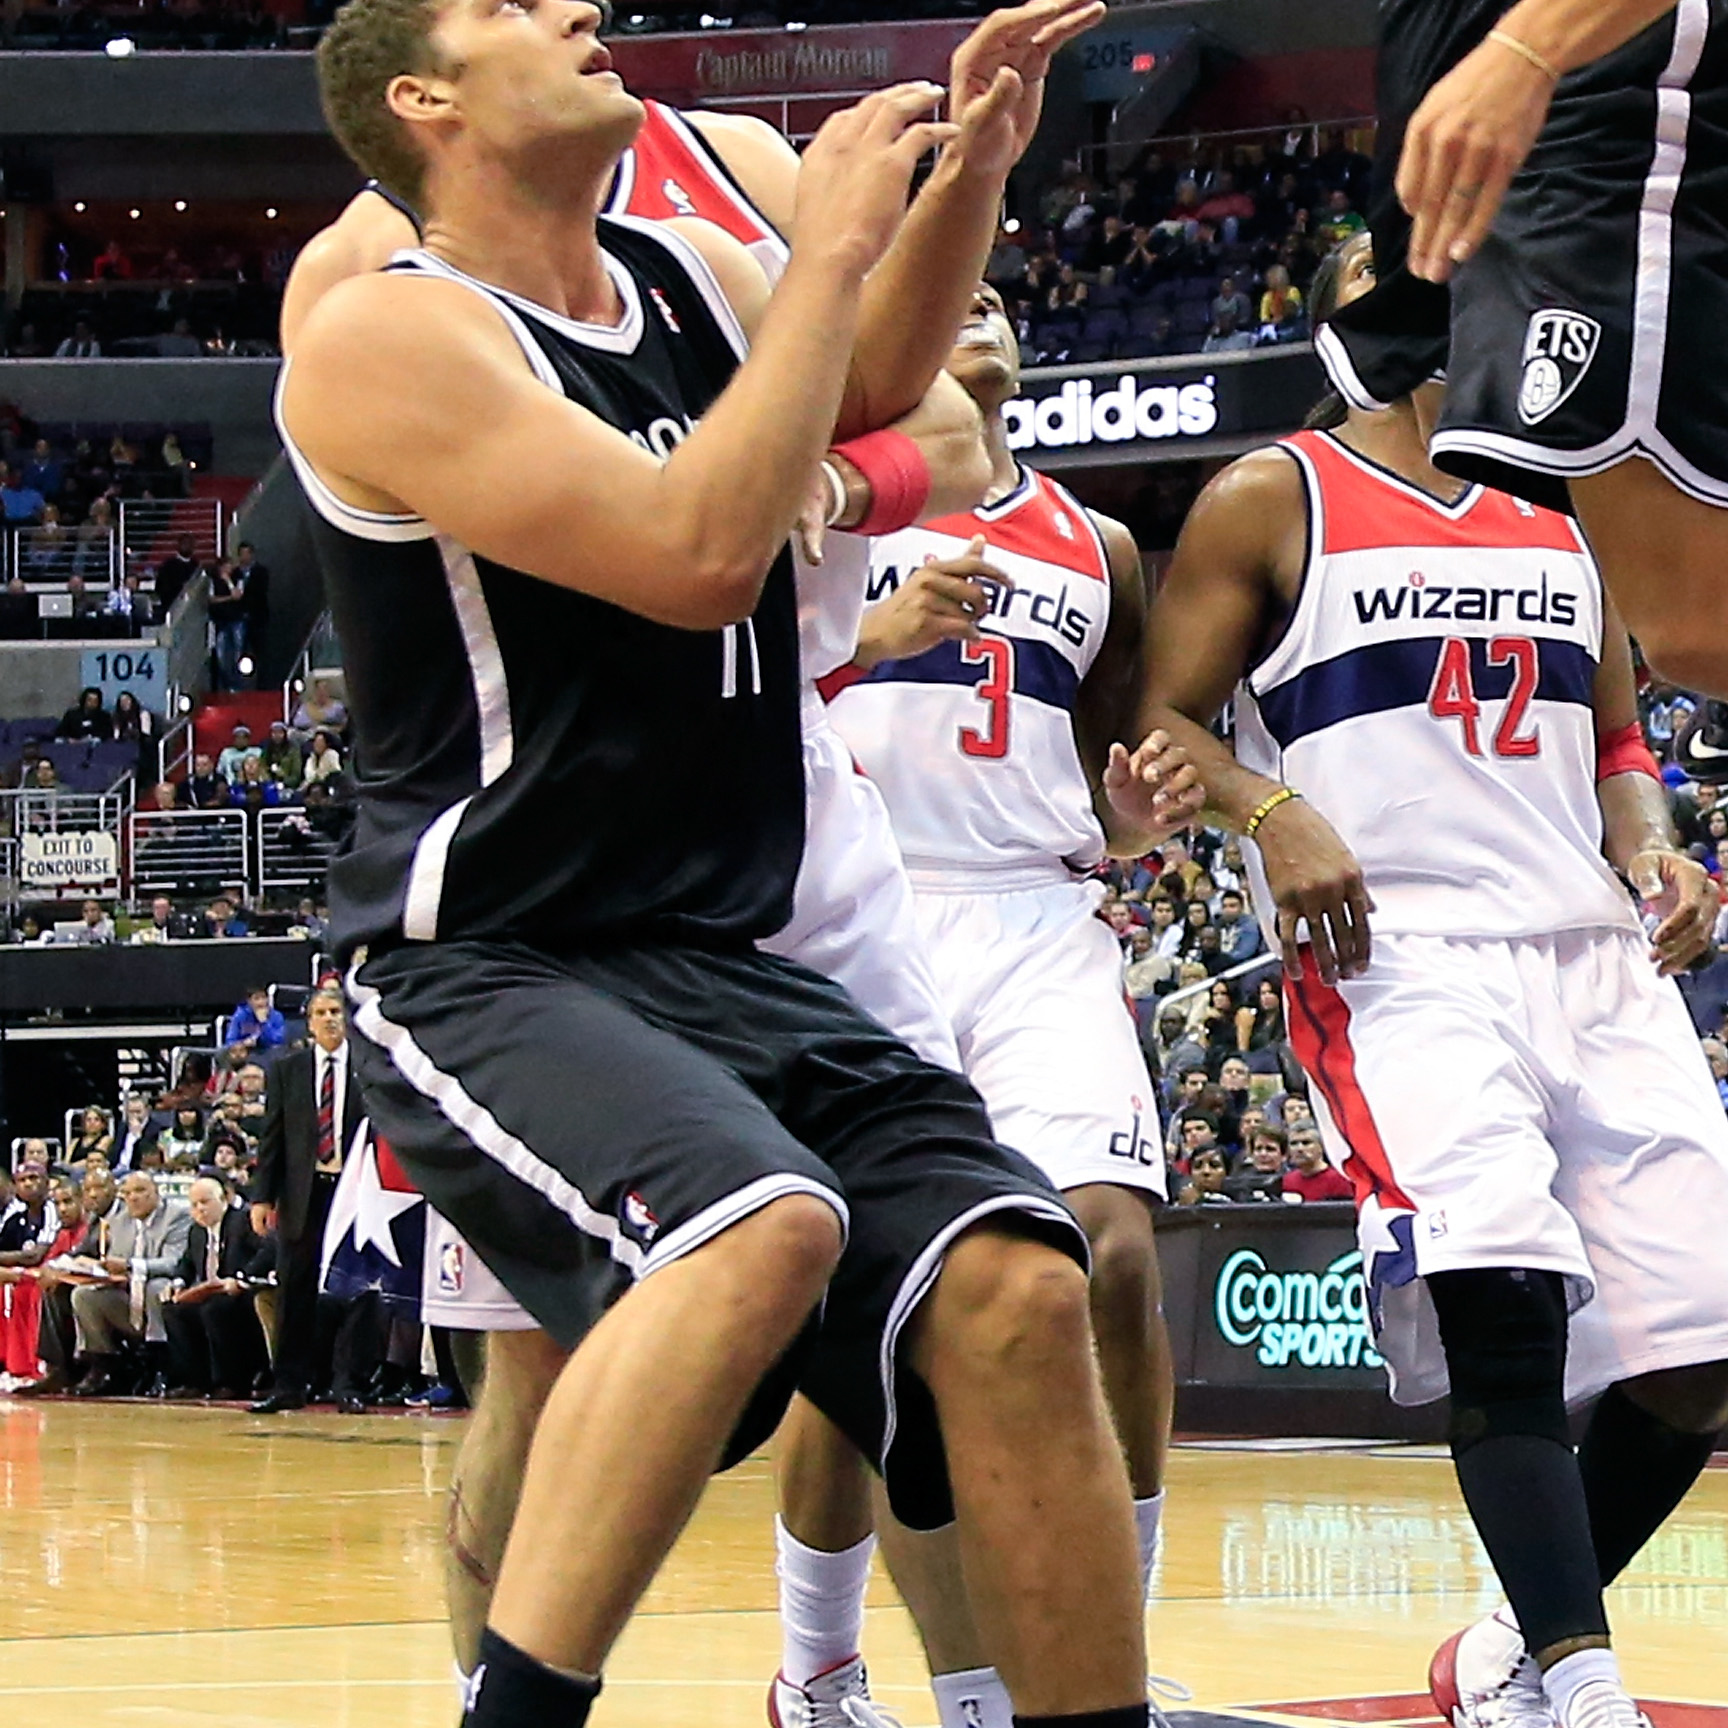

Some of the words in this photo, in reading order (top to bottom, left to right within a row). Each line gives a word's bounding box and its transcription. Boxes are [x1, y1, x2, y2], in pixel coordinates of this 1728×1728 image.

[1085, 40, 1133, 70] 205
[1525, 316, 1591, 363] ETS
[1000, 375, 1217, 450] adidas
[1354, 570, 1578, 626] wizards
[96, 652, 154, 681] 104
[960, 634, 1017, 761] 3
[1427, 634, 1540, 759] 42
[27, 858, 110, 877] CONCOURSE
[43, 839, 73, 855] EXIT
[75, 838, 93, 854] TO
